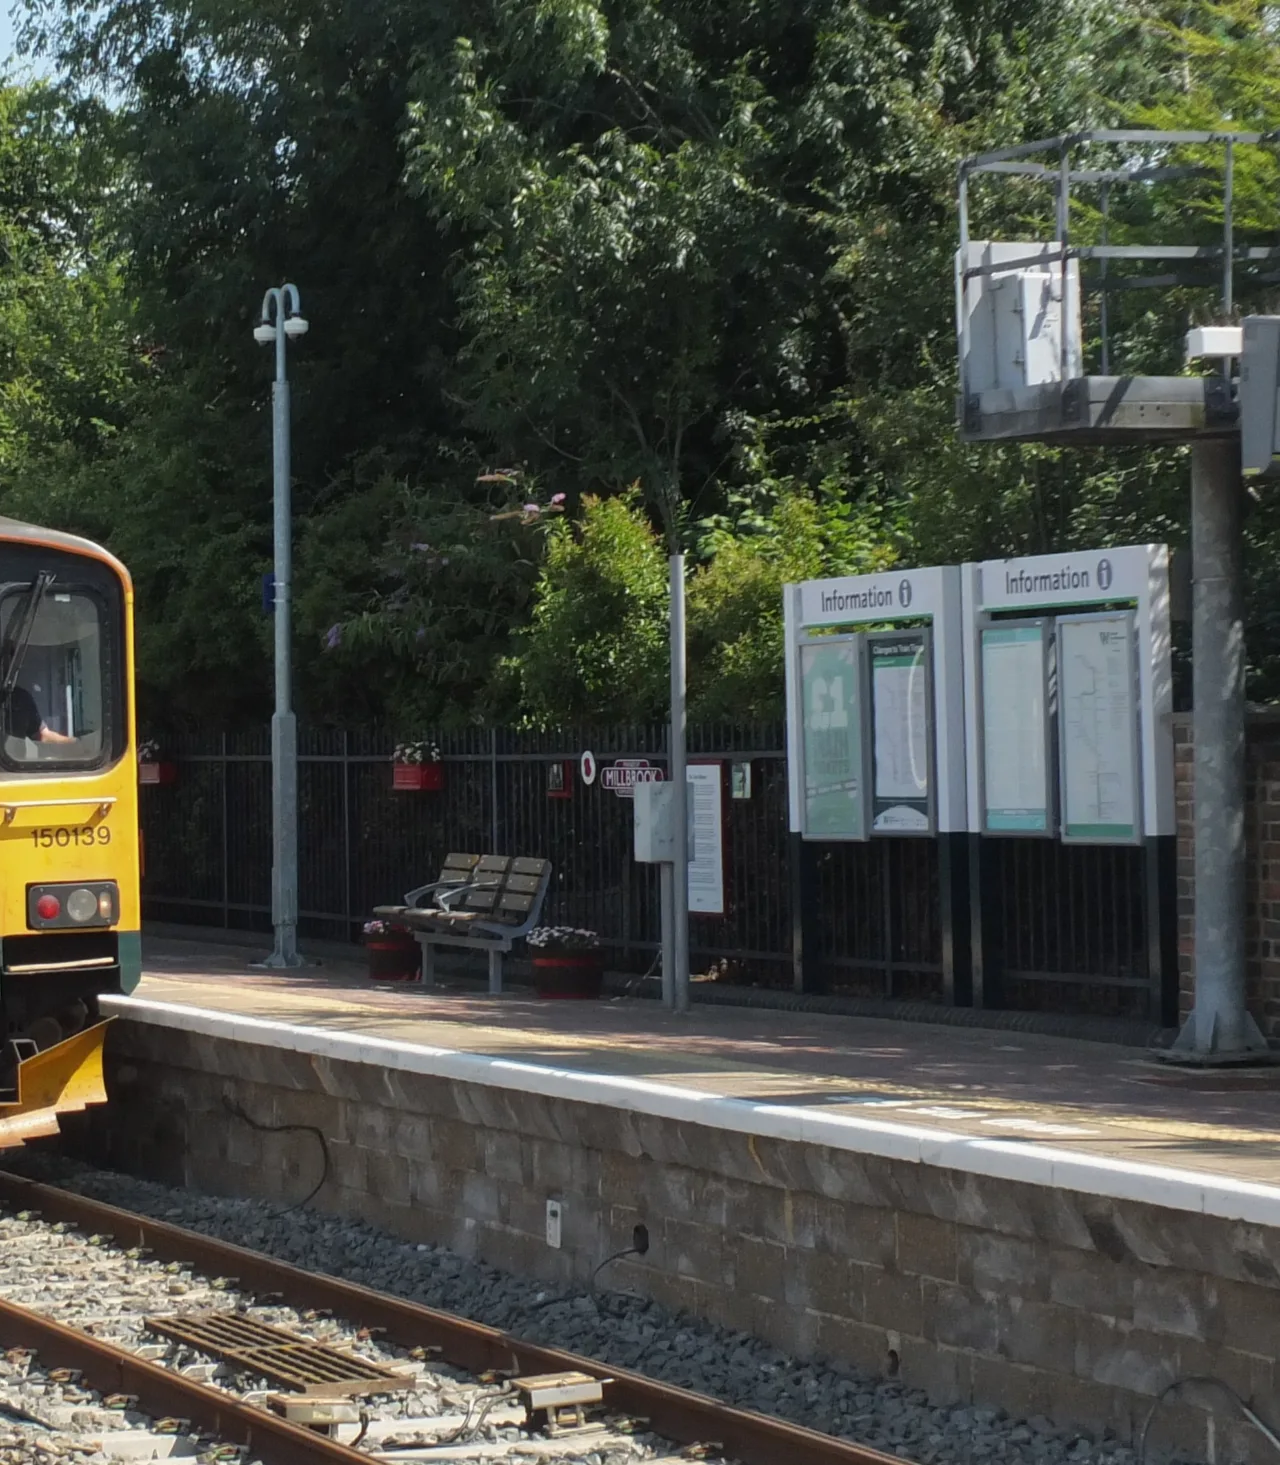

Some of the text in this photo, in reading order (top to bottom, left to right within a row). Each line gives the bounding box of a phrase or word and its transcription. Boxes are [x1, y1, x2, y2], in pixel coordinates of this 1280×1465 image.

[1005, 566, 1090, 594] Information
[821, 585, 893, 613] Information
[606, 770, 657, 786] MILLBROOK
[31, 825, 111, 848] 150139
